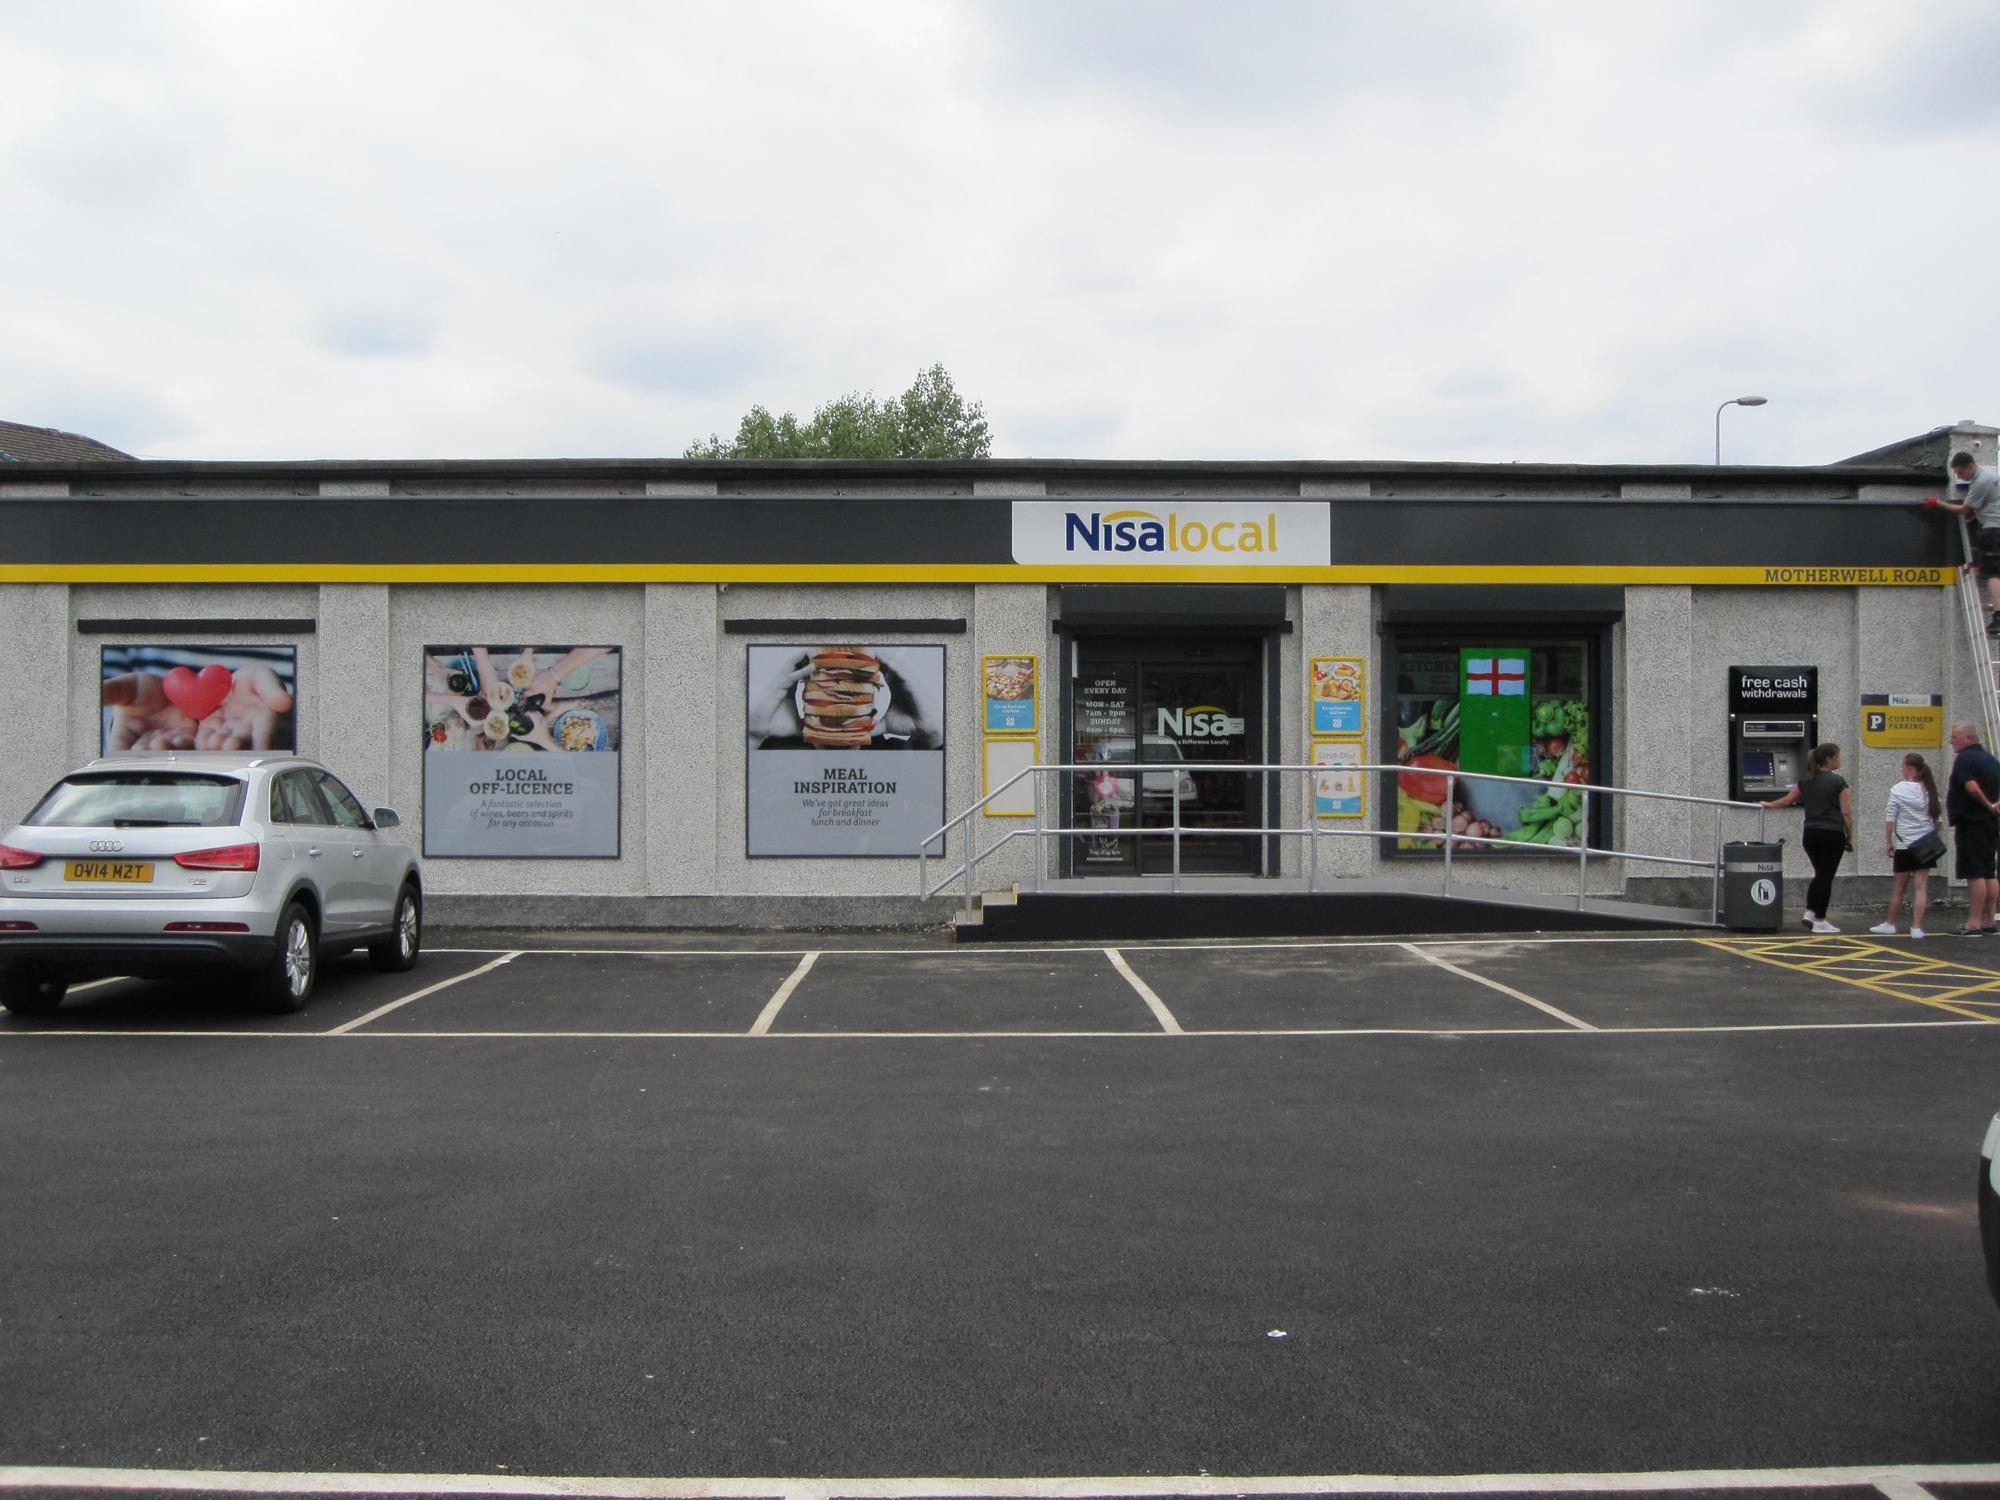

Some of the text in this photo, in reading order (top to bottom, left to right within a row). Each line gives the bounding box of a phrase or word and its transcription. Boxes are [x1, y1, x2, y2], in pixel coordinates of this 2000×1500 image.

[1764, 569, 1941, 583] MOTHERWELL ROAD
[1094, 679, 1116, 687] OPEN
[1741, 675, 1808, 688] free cash
[1084, 687, 1127, 695] EVERY DAY
[1741, 688, 1808, 699] withdrawals
[1157, 706, 1230, 737] Nisa
[1888, 715, 1935, 723] CUSTOMER
[495, 769, 548, 781] LOCAL
[823, 768, 868, 780] MEAL
[469, 782, 574, 795] OFF-LICENCE
[793, 782, 897, 794] INSPIRATION
[487, 800, 524, 810] fantastic
[526, 800, 563, 808] selection
[827, 800, 842, 809] got
[843, 800, 866, 809] great
[867, 799, 889, 807] ideas
[506, 809, 529, 818] beers
[530, 809, 547, 818] and
[548, 810, 574, 820] spirits
[818, 808, 872, 818] for breakfast
[487, 819, 555, 829] for any occasion
[811, 818, 880, 826] lunch and dinner
[73, 863, 144, 879] OV14 MZT
